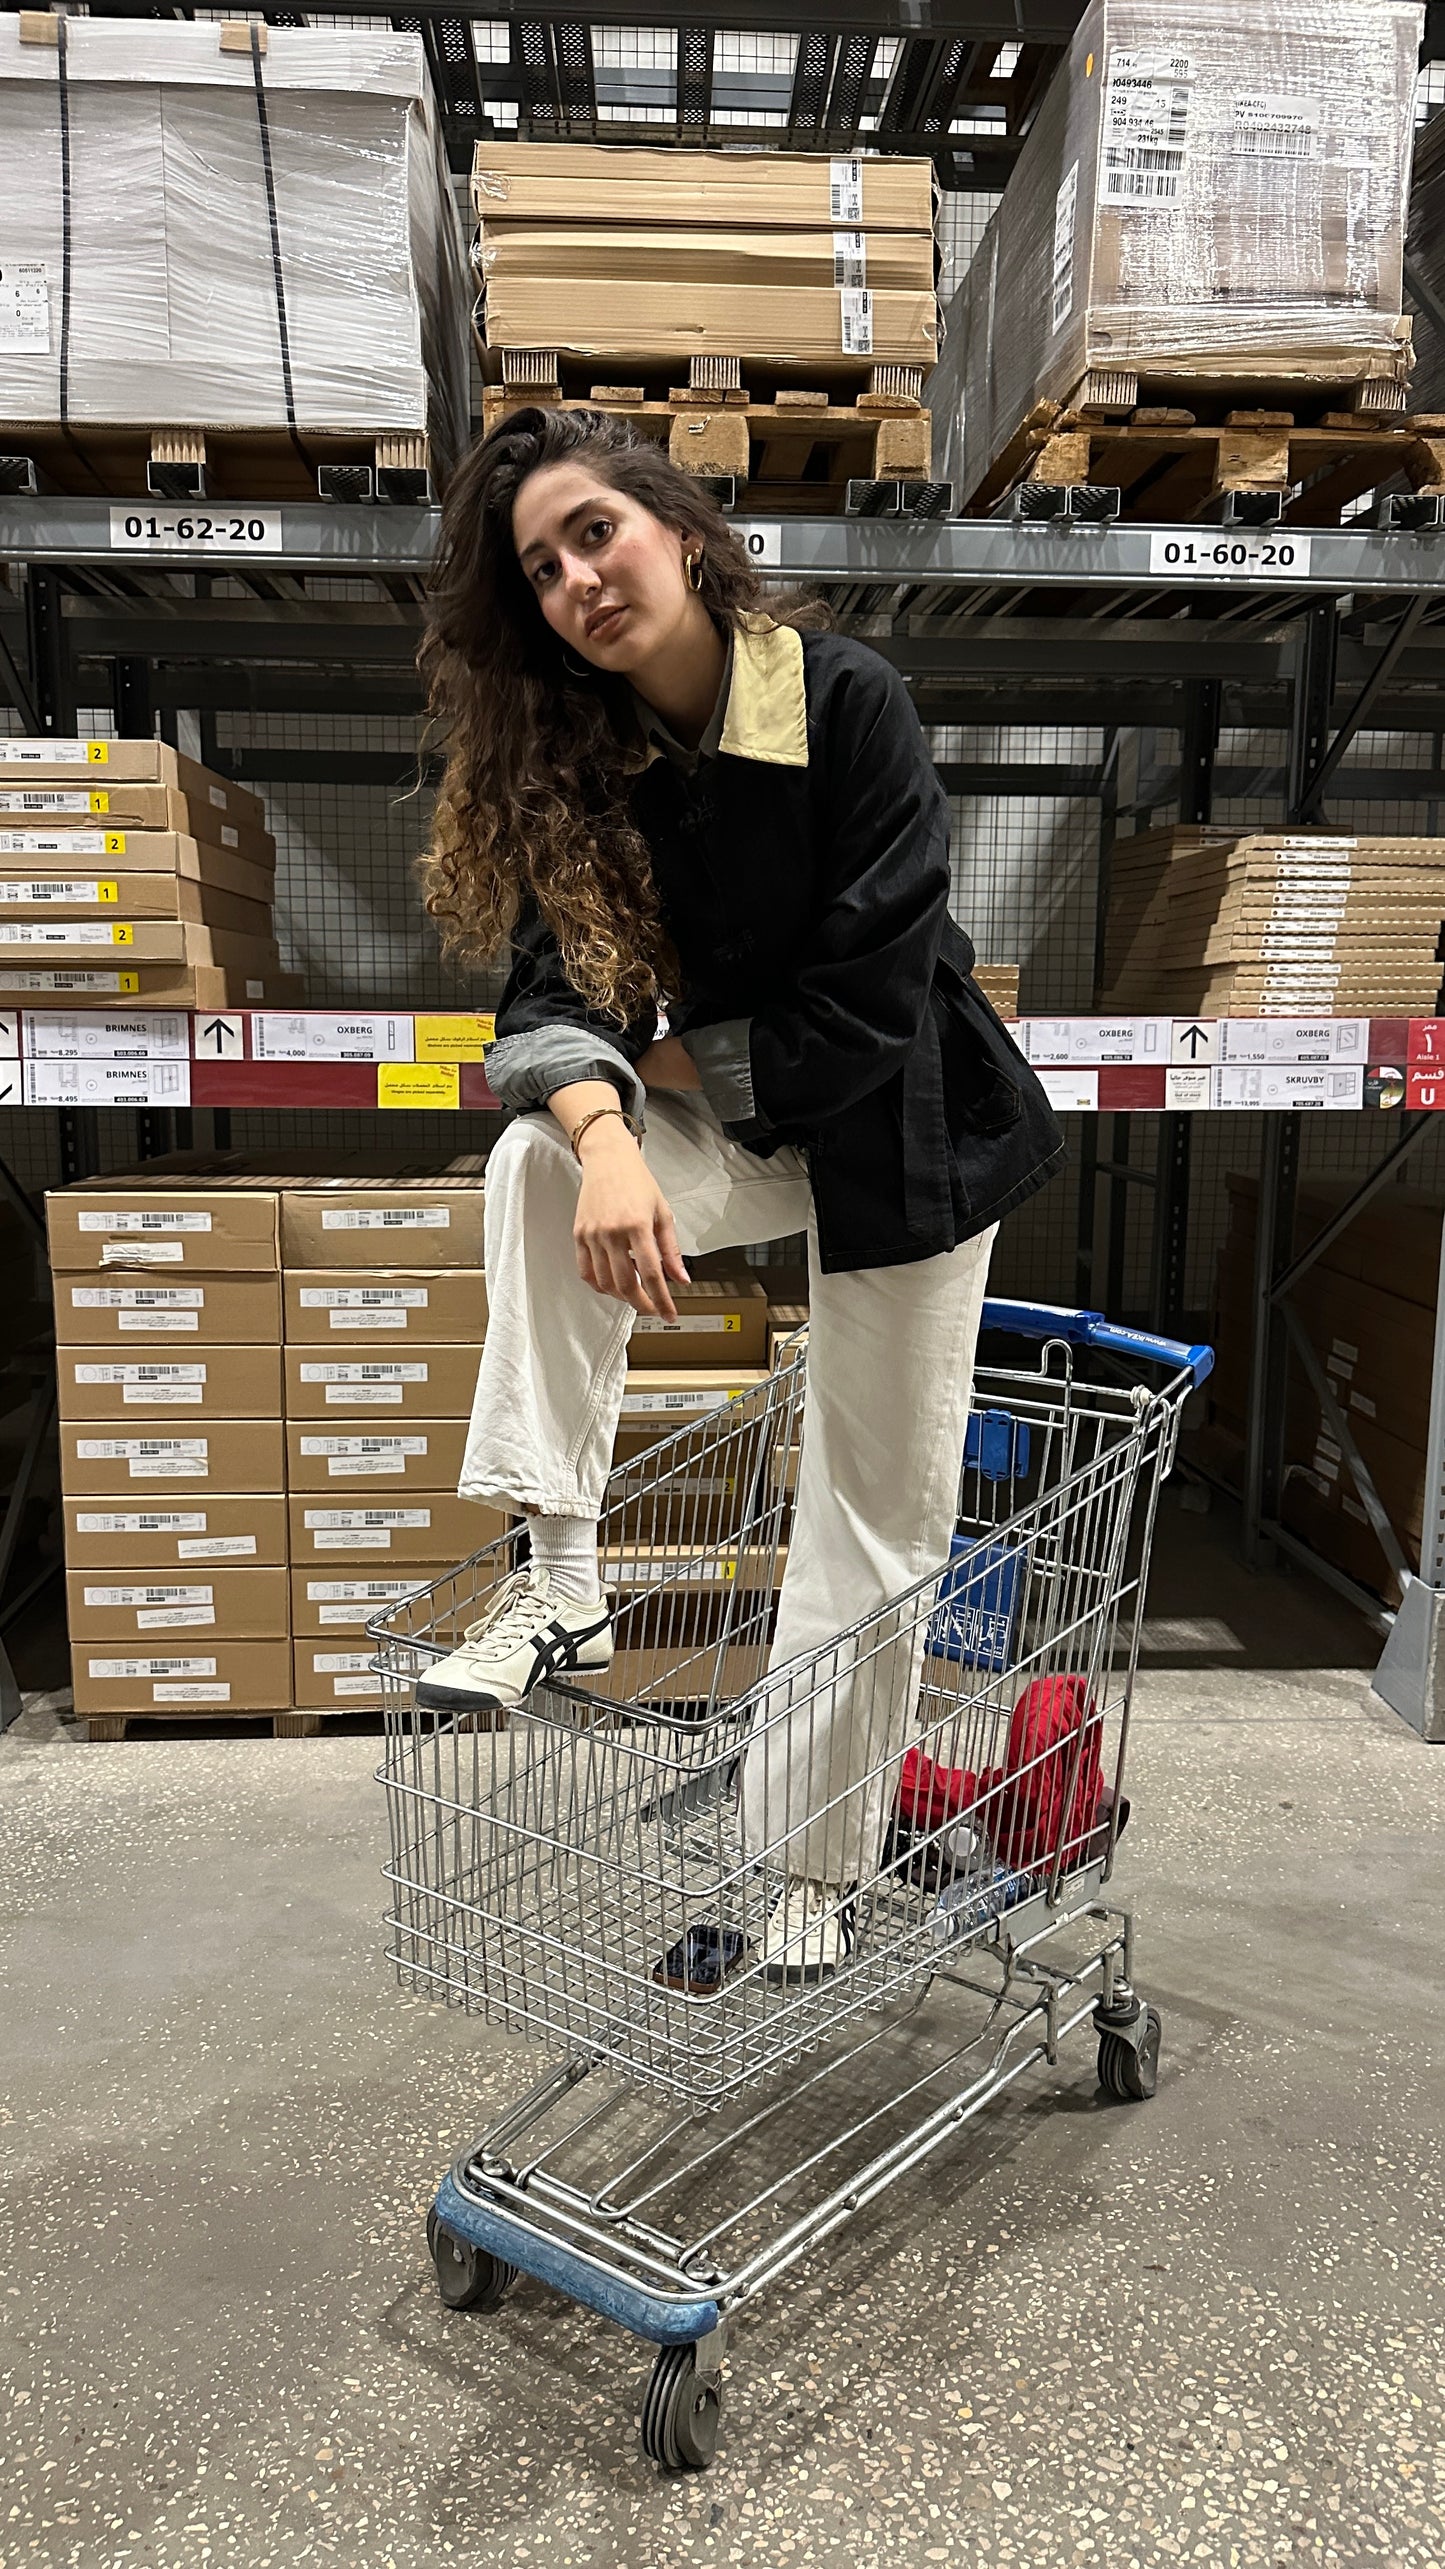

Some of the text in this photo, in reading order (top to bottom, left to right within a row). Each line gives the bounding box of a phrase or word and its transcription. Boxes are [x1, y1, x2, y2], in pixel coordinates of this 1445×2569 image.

[1111, 96, 1127, 105] 249
[124, 517, 266, 541] 01-62-20
[1163, 542, 1295, 566] 01-60-20
[94, 748, 101, 759] 2
[95, 799, 100, 809] 1
[111, 838, 119, 849] 2
[104, 888, 109, 898] 1
[119, 930, 126, 940] 2
[125, 978, 130, 989] 1
[105, 1024, 147, 1032] BRIMNES
[337, 1026, 373, 1034] OXBERG
[1099, 1029, 1133, 1037] OXBERG
[1422, 1024, 1438, 1032] ممر
[106, 1070, 147, 1078] BRIMNES
[1411, 1067, 1444, 1082] قسم
[1285, 1076, 1324, 1084] SKRUVBY
[1420, 1088, 1435, 1105] U
[727, 1320, 733, 1329] 2
